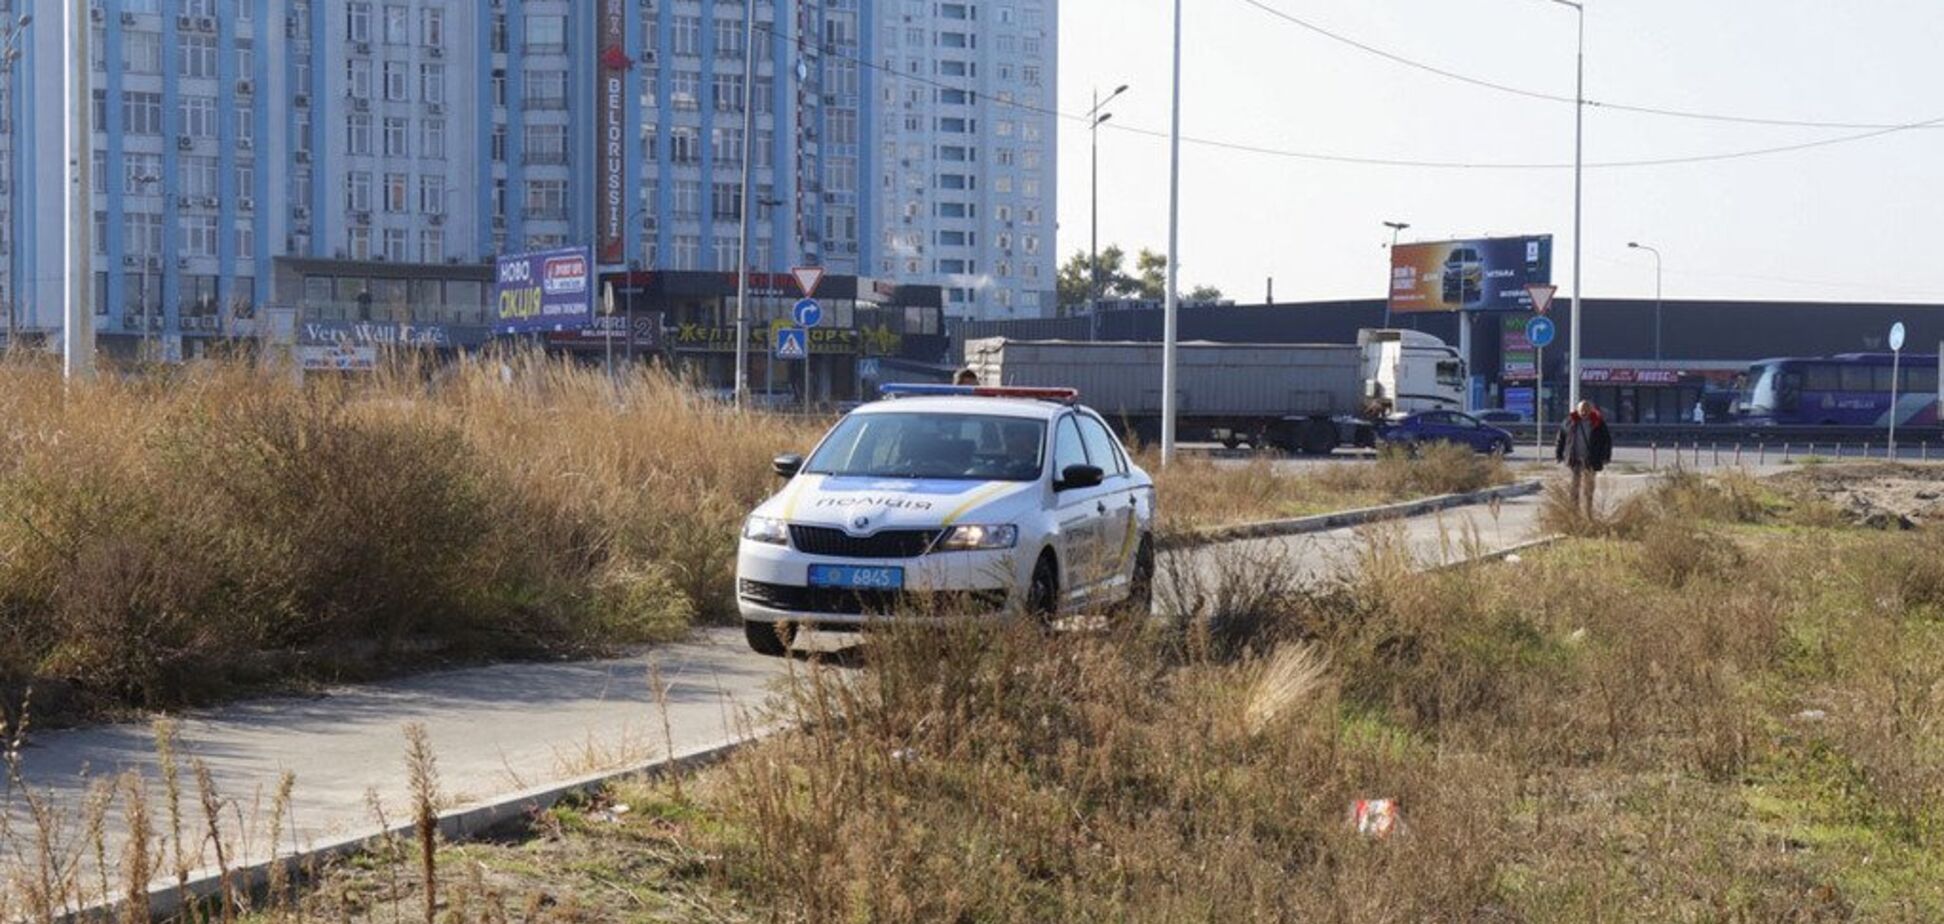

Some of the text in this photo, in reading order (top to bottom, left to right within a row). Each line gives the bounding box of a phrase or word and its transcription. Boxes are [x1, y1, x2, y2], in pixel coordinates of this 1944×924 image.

[608, 79, 621, 238] BELORUSSII
[305, 323, 347, 343] Very
[354, 323, 396, 343] Well
[1580, 370, 1609, 382] AUTO
[816, 498, 932, 511] ПОЛІЦІЯ
[852, 569, 891, 586] 6845
